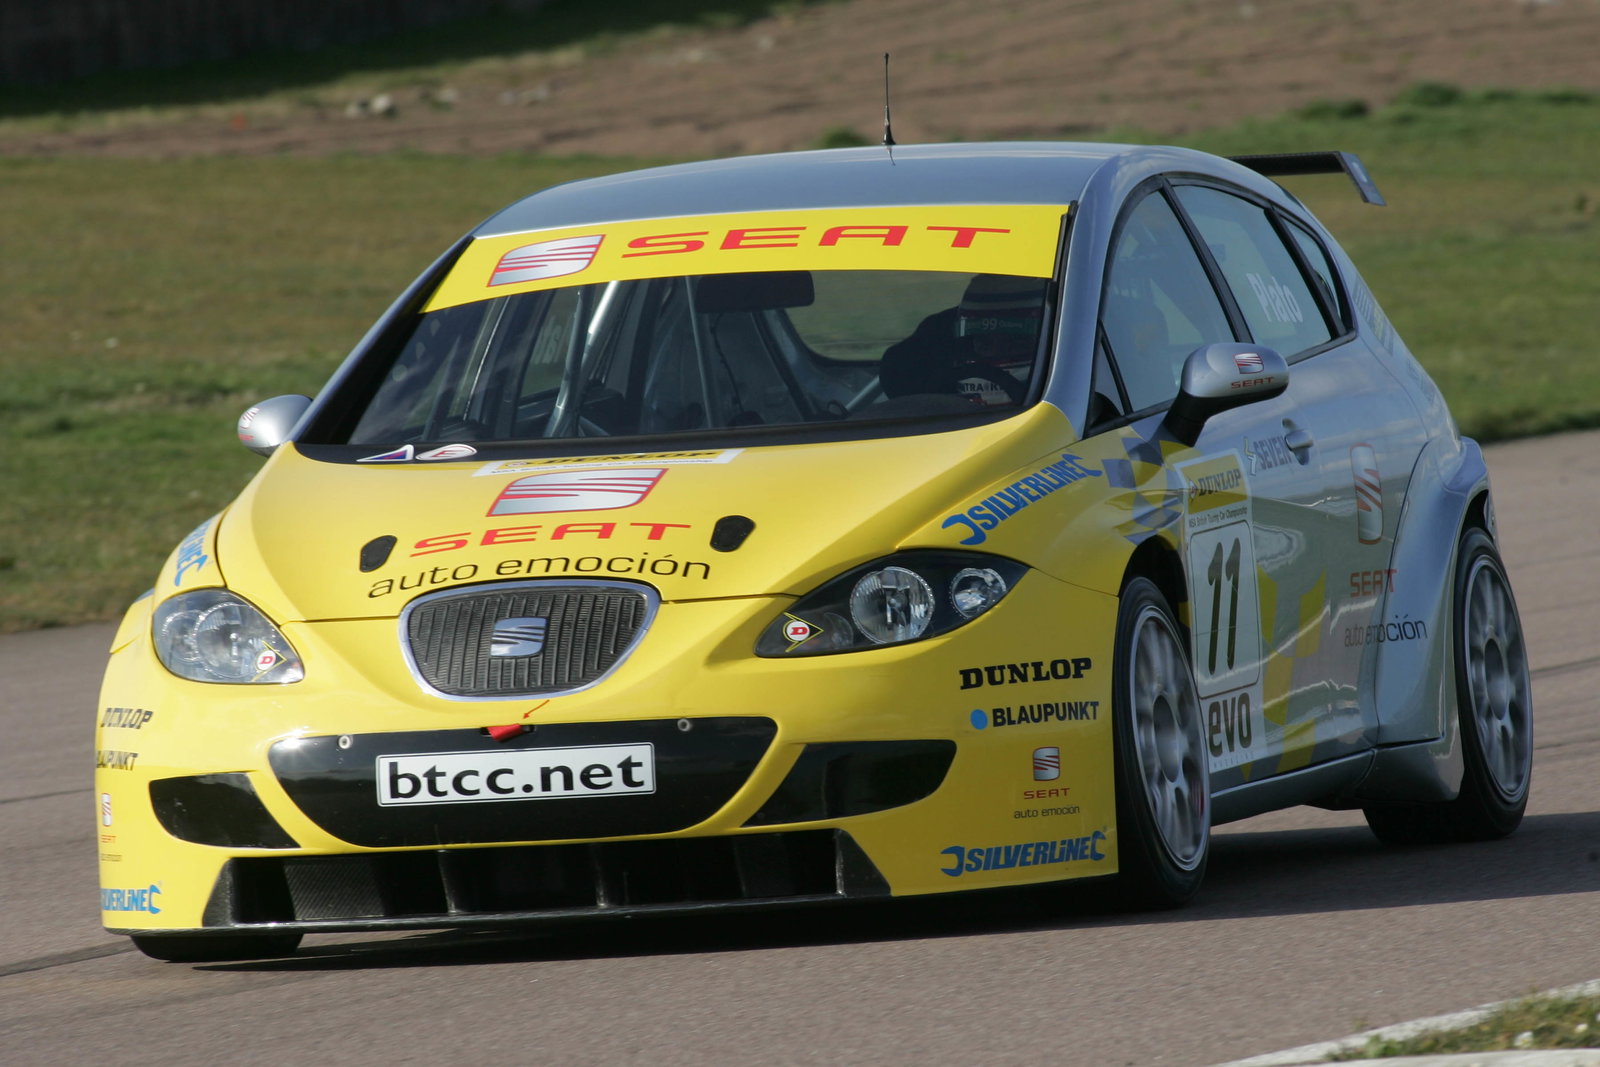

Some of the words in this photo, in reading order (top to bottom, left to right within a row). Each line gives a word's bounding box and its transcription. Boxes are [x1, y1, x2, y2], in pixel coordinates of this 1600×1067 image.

[621, 225, 1011, 259] SEAT
[1246, 273, 1304, 324] Plato
[1231, 376, 1275, 389] SEAT
[541, 450, 718, 466] DUNLOP
[1253, 435, 1292, 470] SEVEN
[1198, 468, 1242, 496] DUNLOP
[409, 522, 692, 557] SEAT
[368, 563, 479, 599] auto
[495, 552, 711, 580] emoción
[1350, 568, 1398, 597] SEAT
[1207, 537, 1242, 676] 11
[1344, 623, 1364, 648] auto
[1365, 613, 1429, 644] emoción
[959, 657, 1093, 690] DUNLOP
[101, 707, 153, 730] DUNLOP
[992, 701, 1100, 728] BLAUPUNKT
[1208, 692, 1253, 758] evo
[388, 755, 645, 799] btcc.net
[1023, 787, 1071, 800] SEAT
[1013, 808, 1039, 820] auto
